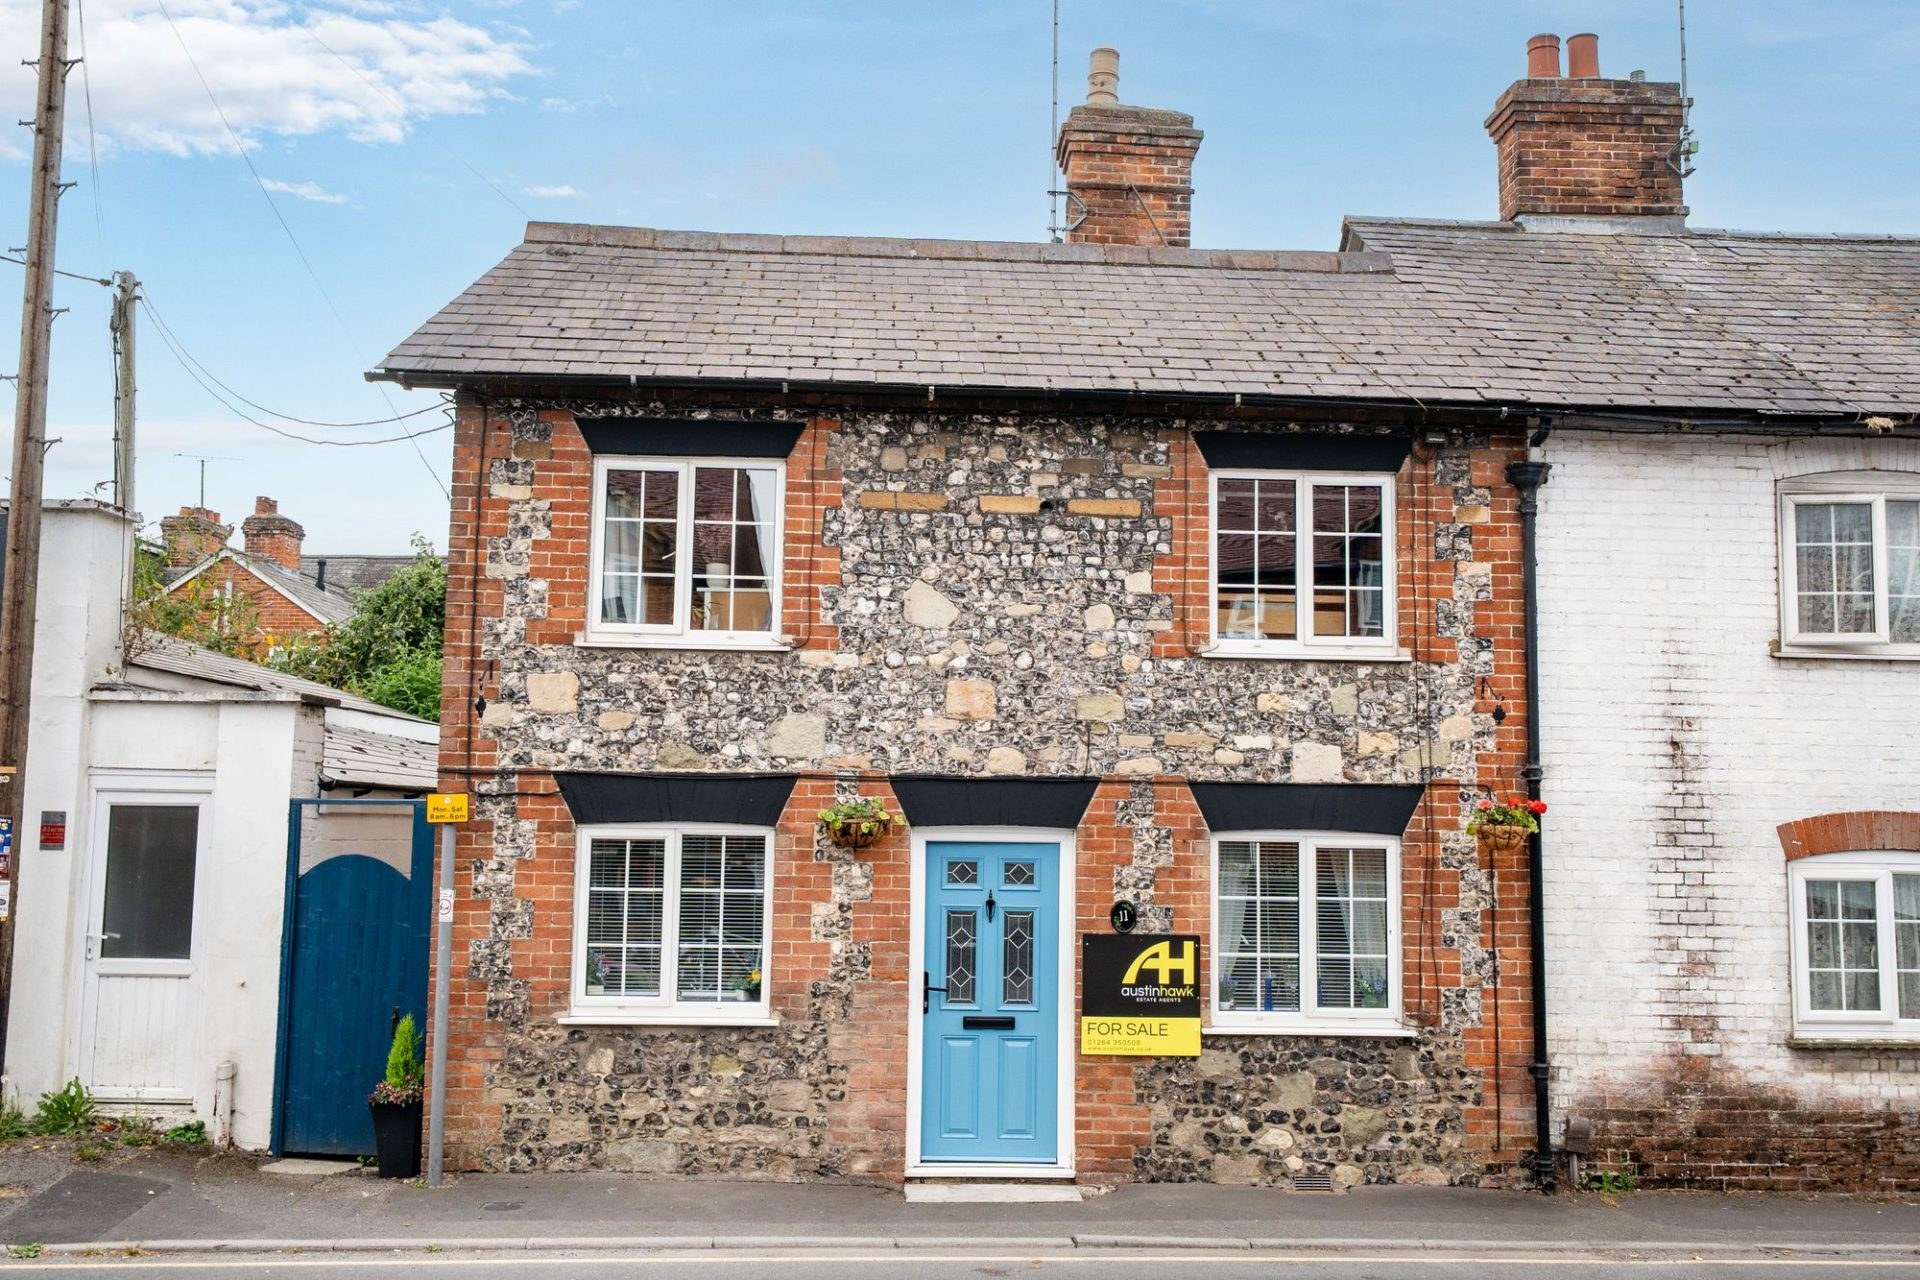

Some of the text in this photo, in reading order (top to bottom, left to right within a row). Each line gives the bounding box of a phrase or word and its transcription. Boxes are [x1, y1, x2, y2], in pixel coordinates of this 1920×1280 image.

[1119, 910, 1128, 921] 11
[1122, 941, 1194, 984] AH
[1121, 985, 1194, 997] austinhawk
[1087, 1022, 1169, 1037] FOR SALE
